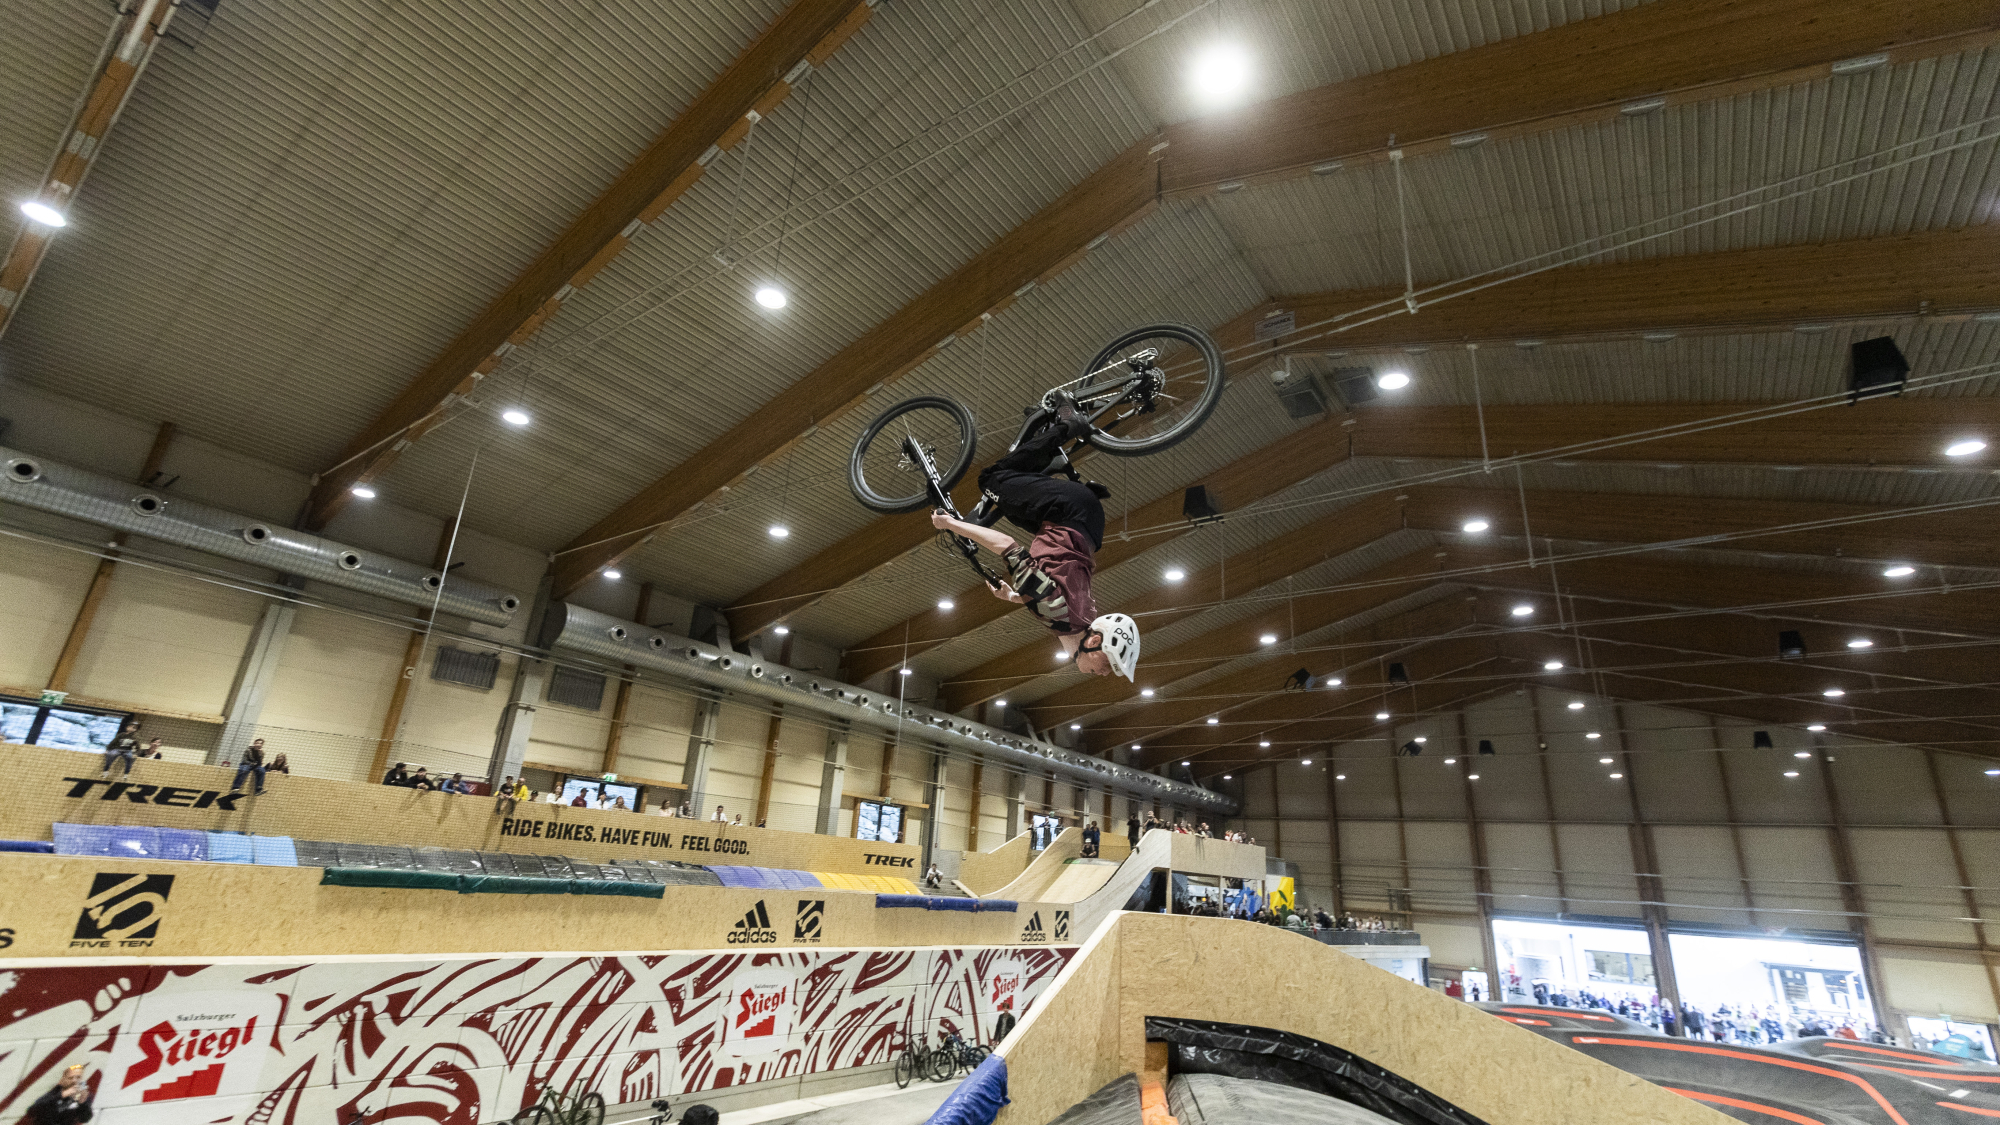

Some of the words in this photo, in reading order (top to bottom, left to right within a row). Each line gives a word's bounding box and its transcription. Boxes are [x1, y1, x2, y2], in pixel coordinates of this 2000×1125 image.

[62, 777, 248, 811] TREK
[500, 817, 543, 838] RIDE
[545, 822, 596, 842] BIKES.
[600, 827, 640, 846] HAVE
[642, 831, 672, 848] FUN.
[681, 835, 711, 852] FEEL
[713, 838, 750, 855] GOOD.
[863, 853, 916, 868] TREK
[69, 940, 111, 948] FIVE
[118, 939, 155, 948] TEN
[727, 927, 777, 944] adidas
[992, 973, 1019, 1004] Stiegl
[175, 1013, 237, 1022] Salzburger
[735, 985, 787, 1030] Stiegl
[121, 1015, 259, 1090] Stiegl
